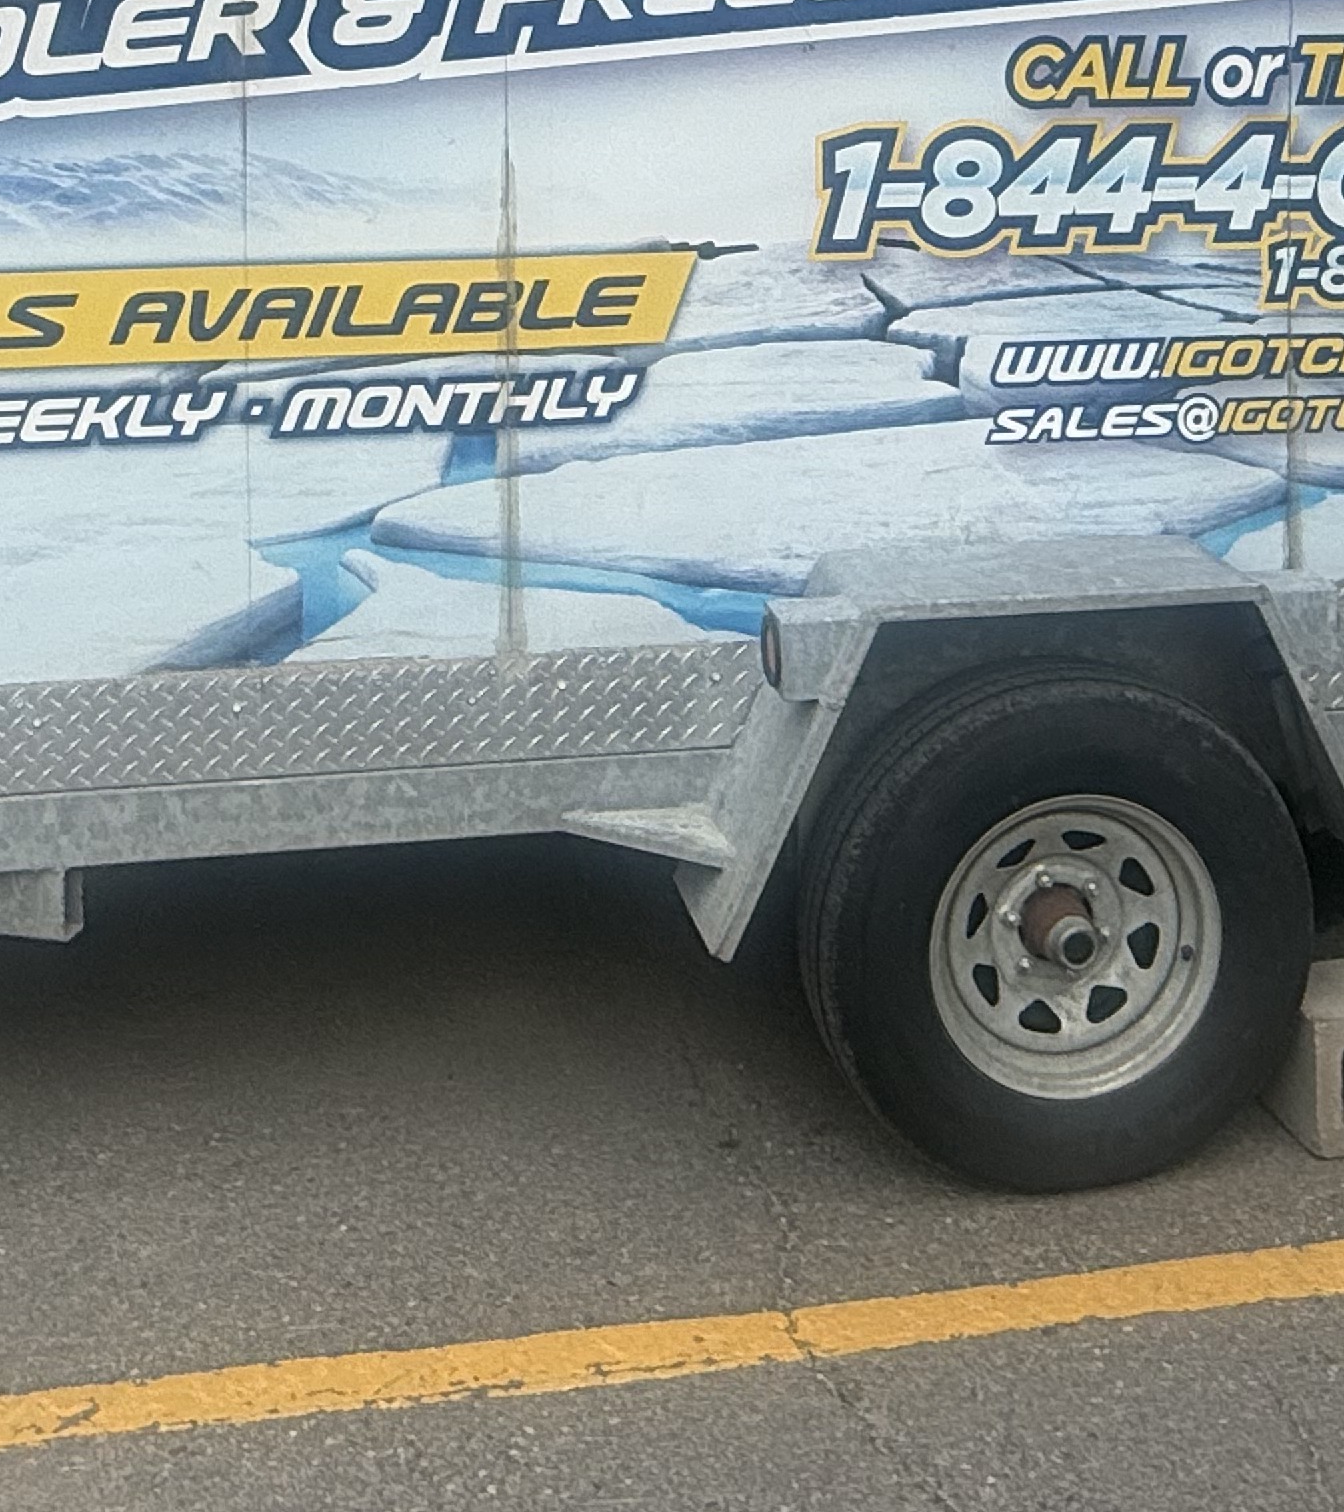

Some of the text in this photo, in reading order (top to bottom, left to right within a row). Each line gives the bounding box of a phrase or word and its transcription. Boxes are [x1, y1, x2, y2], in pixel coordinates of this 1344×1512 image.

[1011, 38, 1194, 102] CALL
[1210, 45, 1288, 95] or
[109, 274, 647, 346] AVAILABLE
[278, 372, 638, 434] MONTHLY
